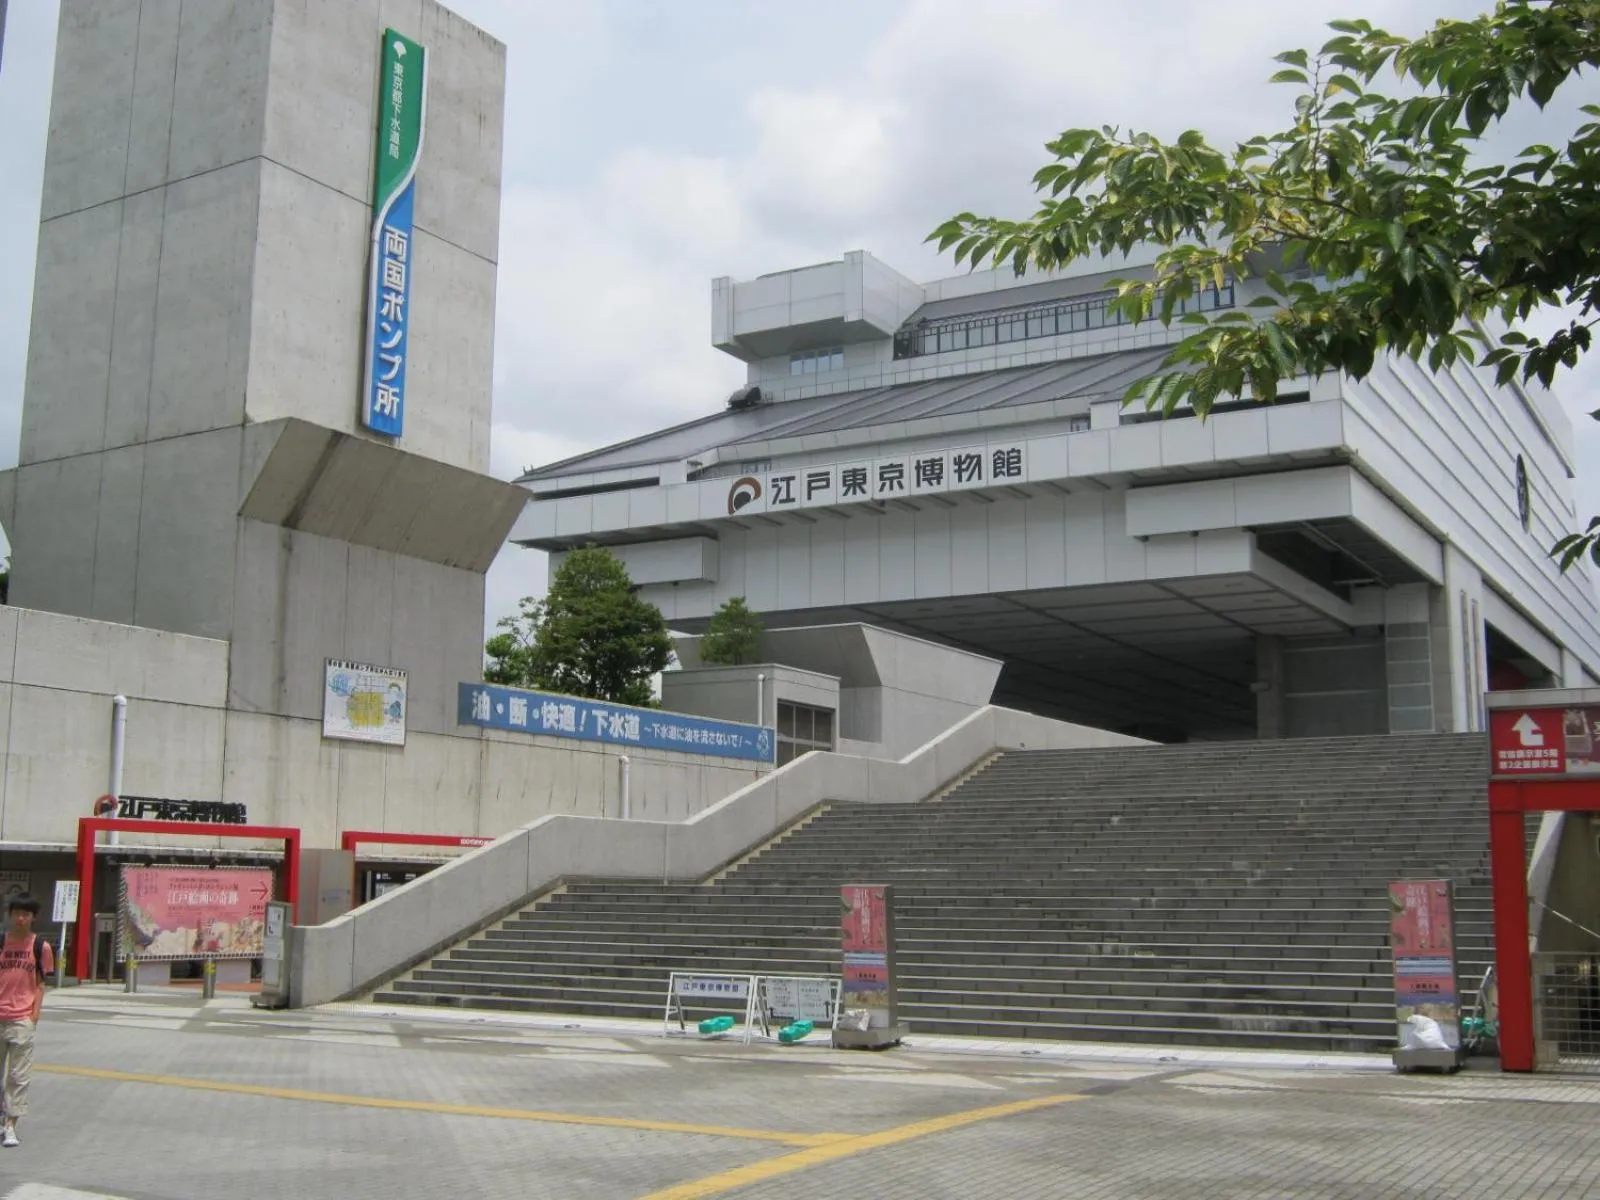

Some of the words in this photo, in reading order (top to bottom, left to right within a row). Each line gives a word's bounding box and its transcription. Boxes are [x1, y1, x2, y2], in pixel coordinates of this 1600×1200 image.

[387, 61, 405, 159] 東京都下水道局
[374, 225, 408, 419] 両国ポンプ所
[770, 447, 1022, 505] 江戸東京博物館
[118, 796, 248, 824] 江戸東京博物館
